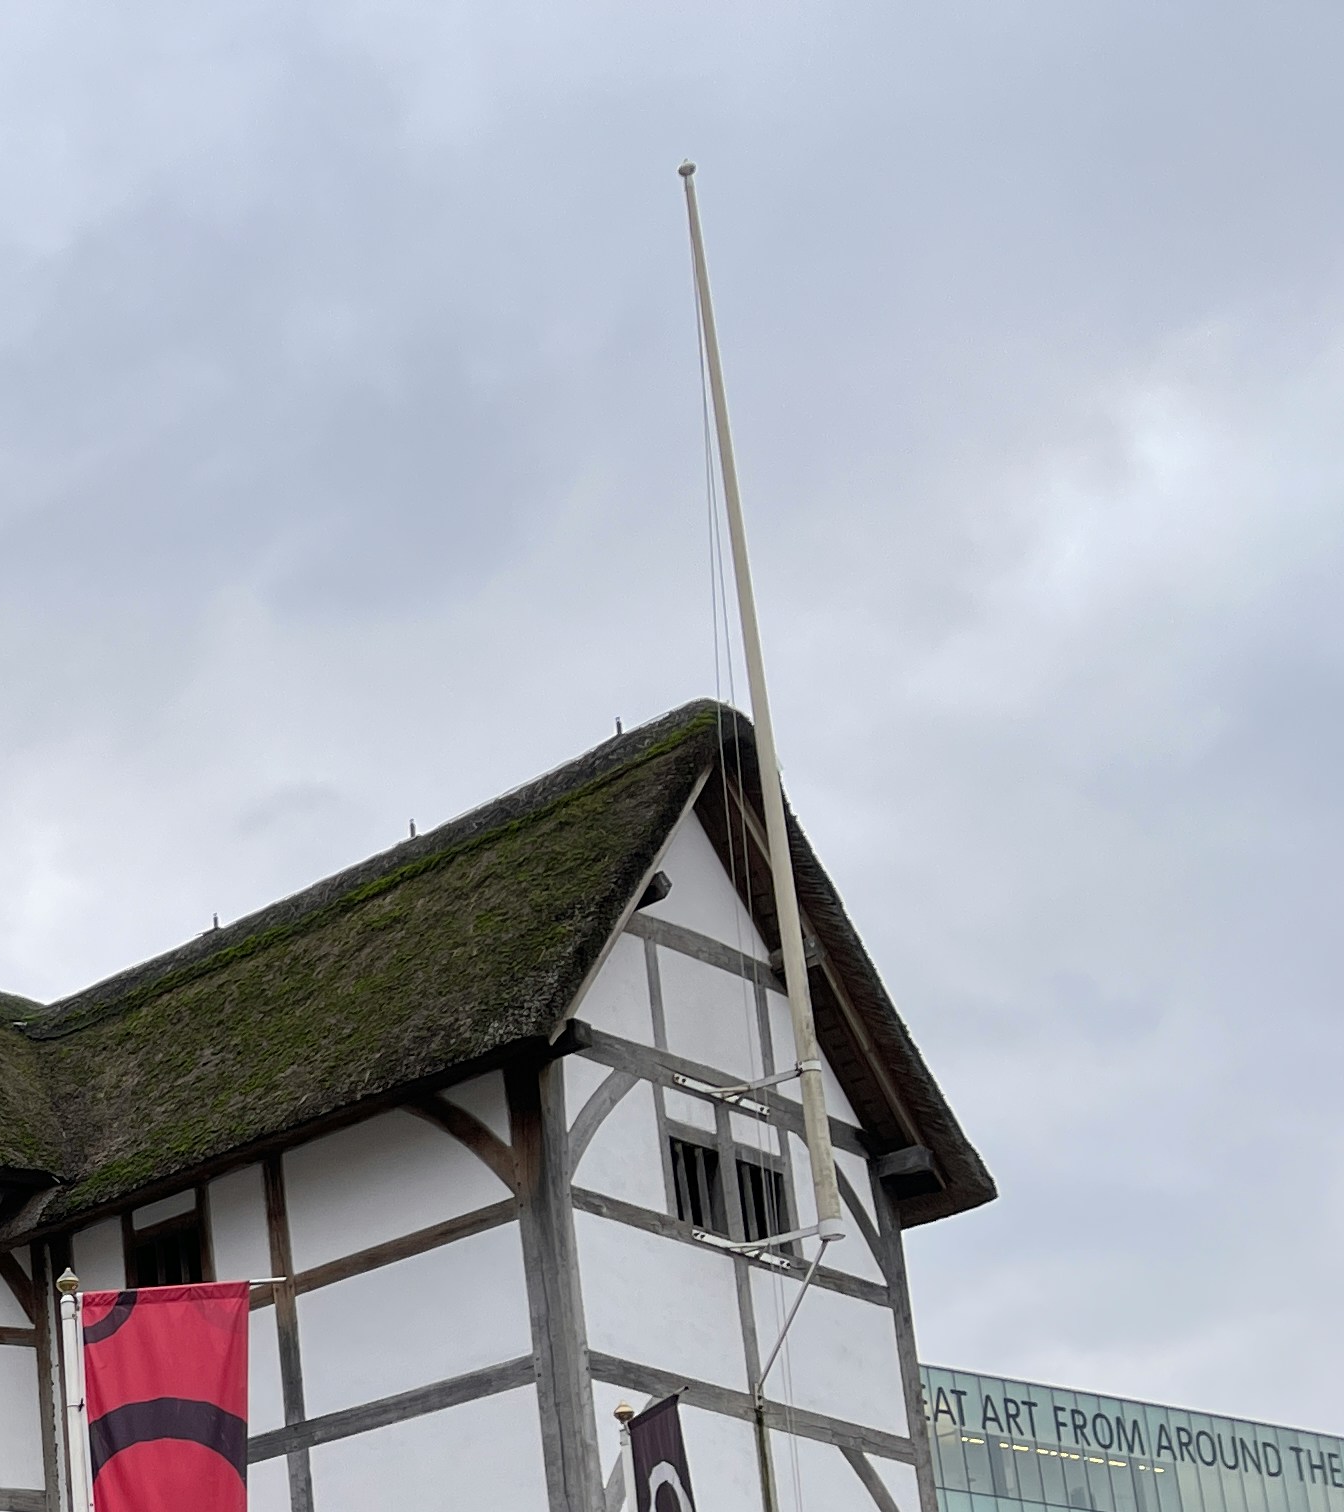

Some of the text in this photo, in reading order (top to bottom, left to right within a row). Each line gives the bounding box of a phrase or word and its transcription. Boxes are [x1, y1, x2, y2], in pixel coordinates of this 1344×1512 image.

[981, 1394, 1039, 1439] ART
[1053, 1405, 1146, 1457] FROM
[1156, 1423, 1282, 1478] AROUND
[1289, 1445, 1344, 1488] THE
